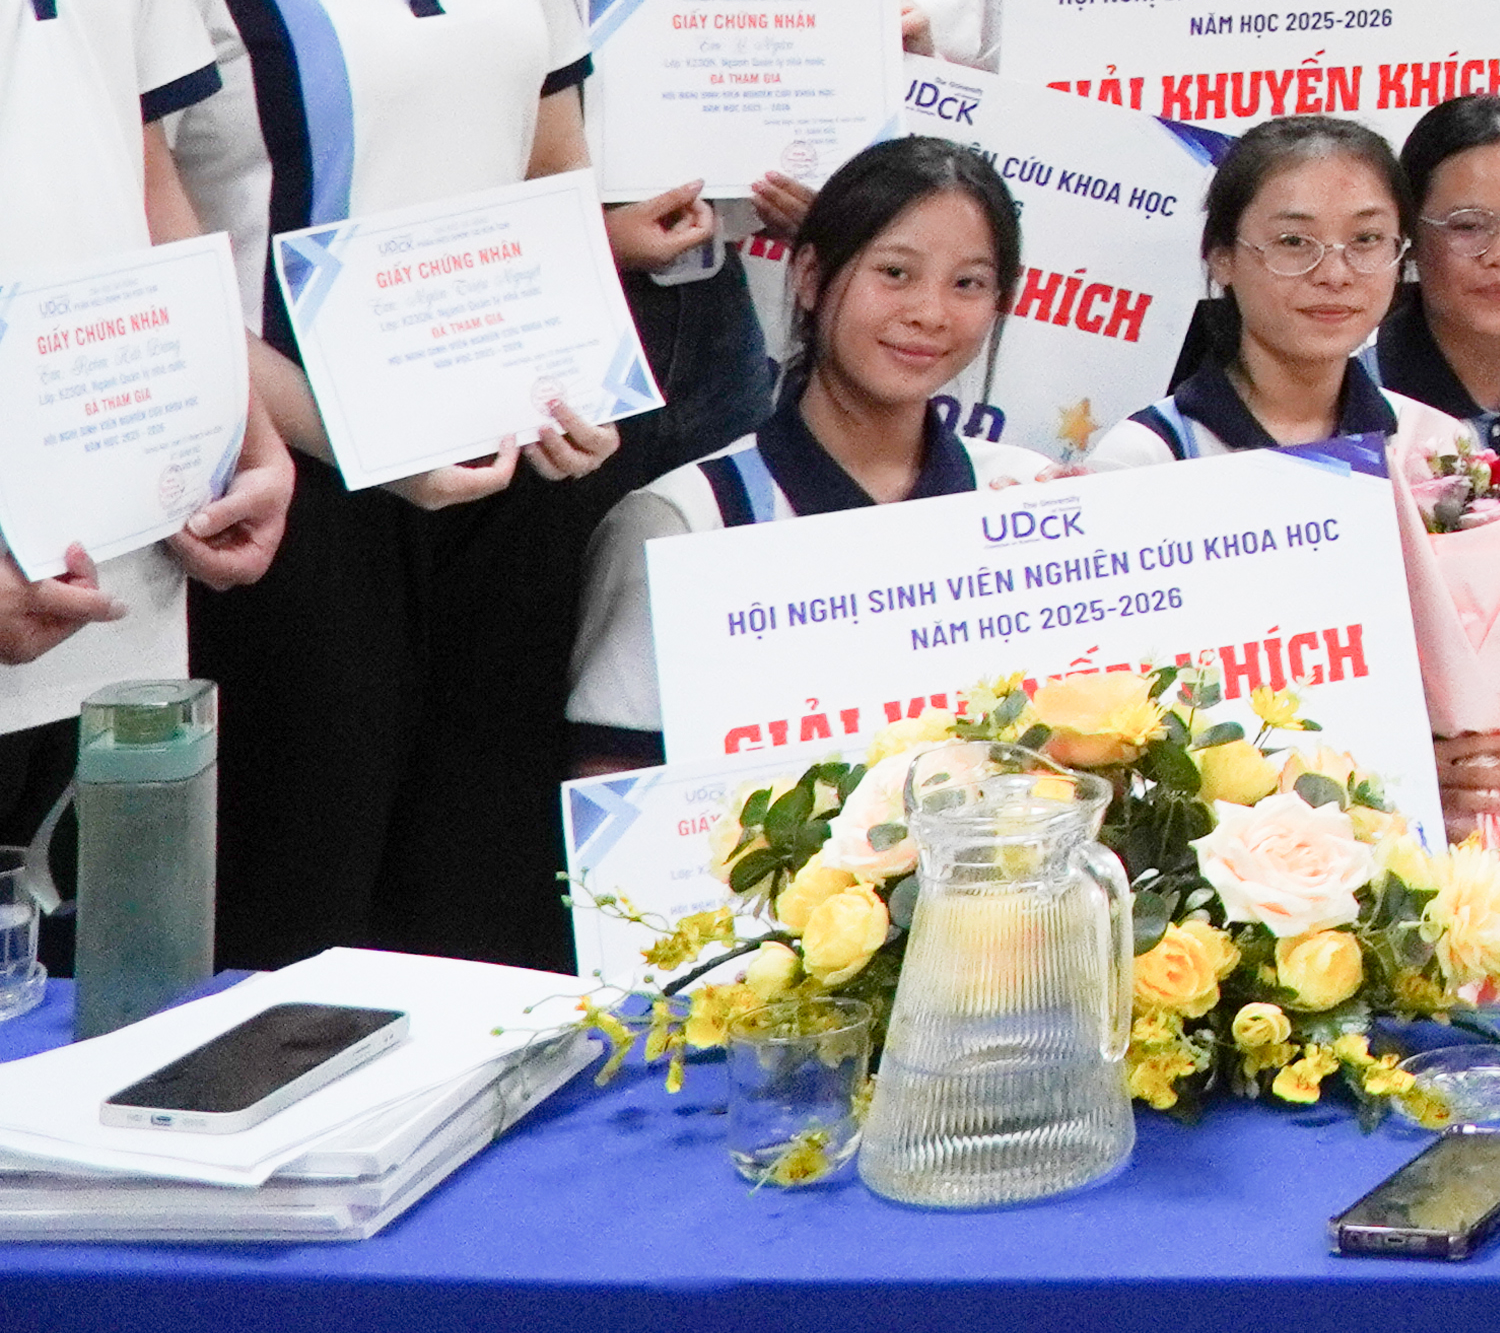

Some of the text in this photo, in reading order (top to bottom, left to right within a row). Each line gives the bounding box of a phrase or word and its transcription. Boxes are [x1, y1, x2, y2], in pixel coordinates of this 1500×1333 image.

[1190, 8, 1392, 37] NĂM HỌC 2025-2026
[1161, 51, 1362, 120] KHUYẾN
[999, 157, 1177, 217] CỨU KHOA HỌC
[1000, 268, 1152, 342] HÍCH
[982, 507, 1085, 545] UDCK
[728, 519, 1339, 640] HỘI NGHỊ SINH VIÊN NGHIÊN CỨU KHOA HỌC
[911, 587, 1182, 650] NĂM HỌC 2025-2026
